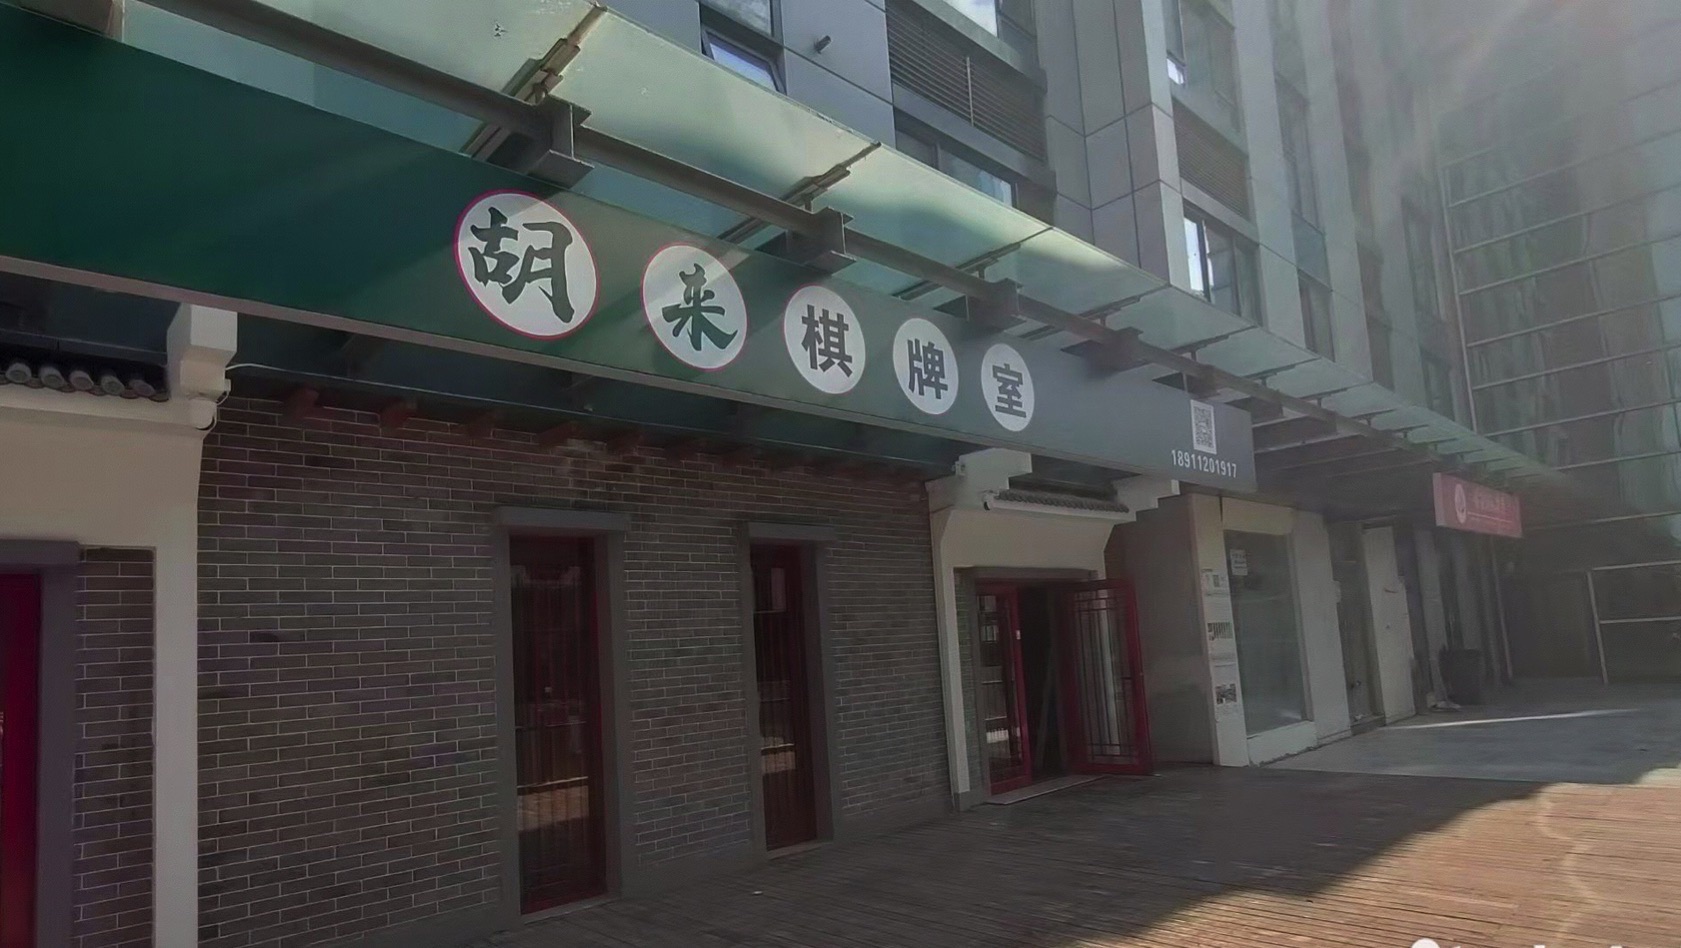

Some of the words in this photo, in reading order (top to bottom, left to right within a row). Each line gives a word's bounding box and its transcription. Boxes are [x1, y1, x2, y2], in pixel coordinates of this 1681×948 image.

[468, 206, 1027, 419] 胡来棋牌室
[1171, 450, 1237, 478] 18911201917
